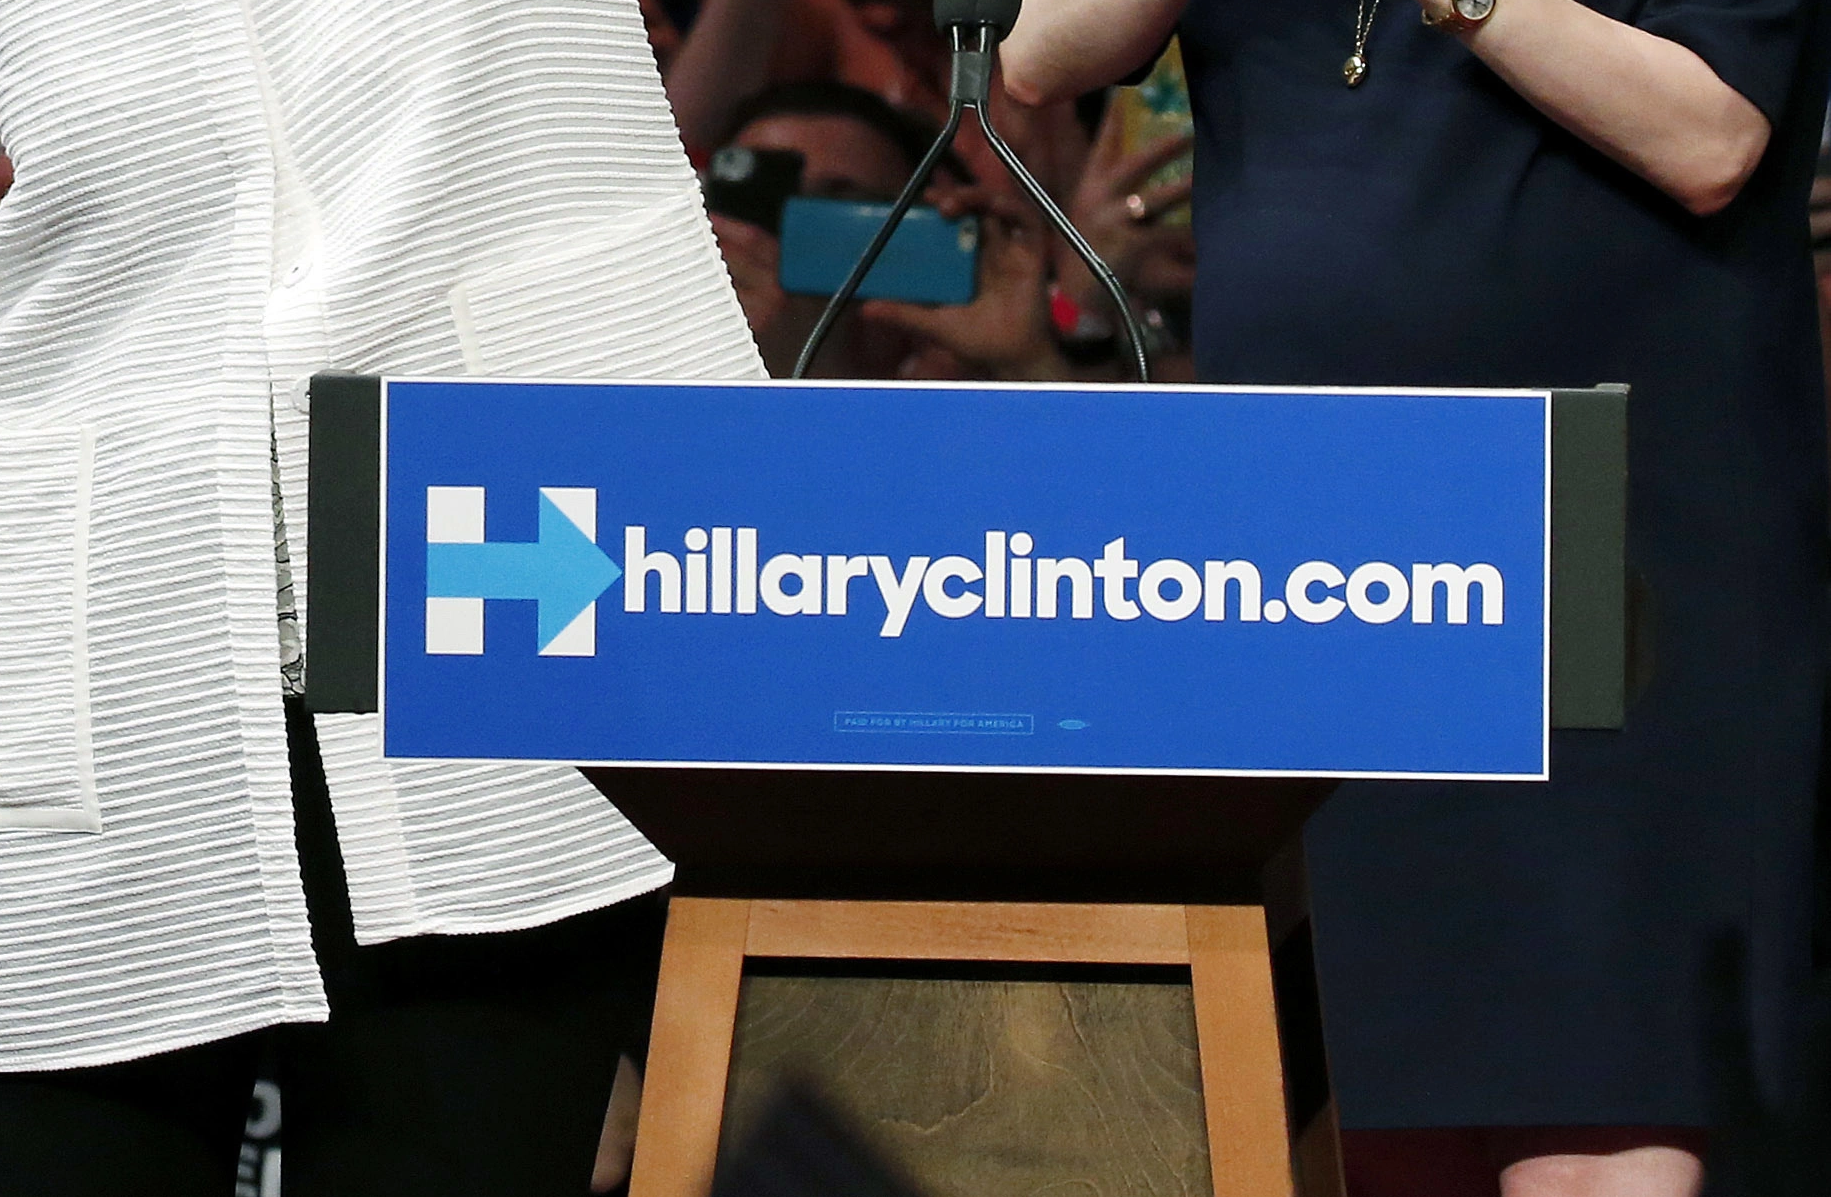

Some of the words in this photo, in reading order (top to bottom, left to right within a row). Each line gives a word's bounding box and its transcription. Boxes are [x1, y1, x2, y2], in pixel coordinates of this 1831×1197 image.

[624, 525, 1504, 638] hillaryclinton.com
[844, 717, 869, 726] PAID
[870, 717, 892, 727] FOR
[893, 718, 908, 727] BY
[909, 718, 952, 728] HILLARY
[953, 719, 976, 728] FOR
[977, 719, 1025, 729] AMERICA
